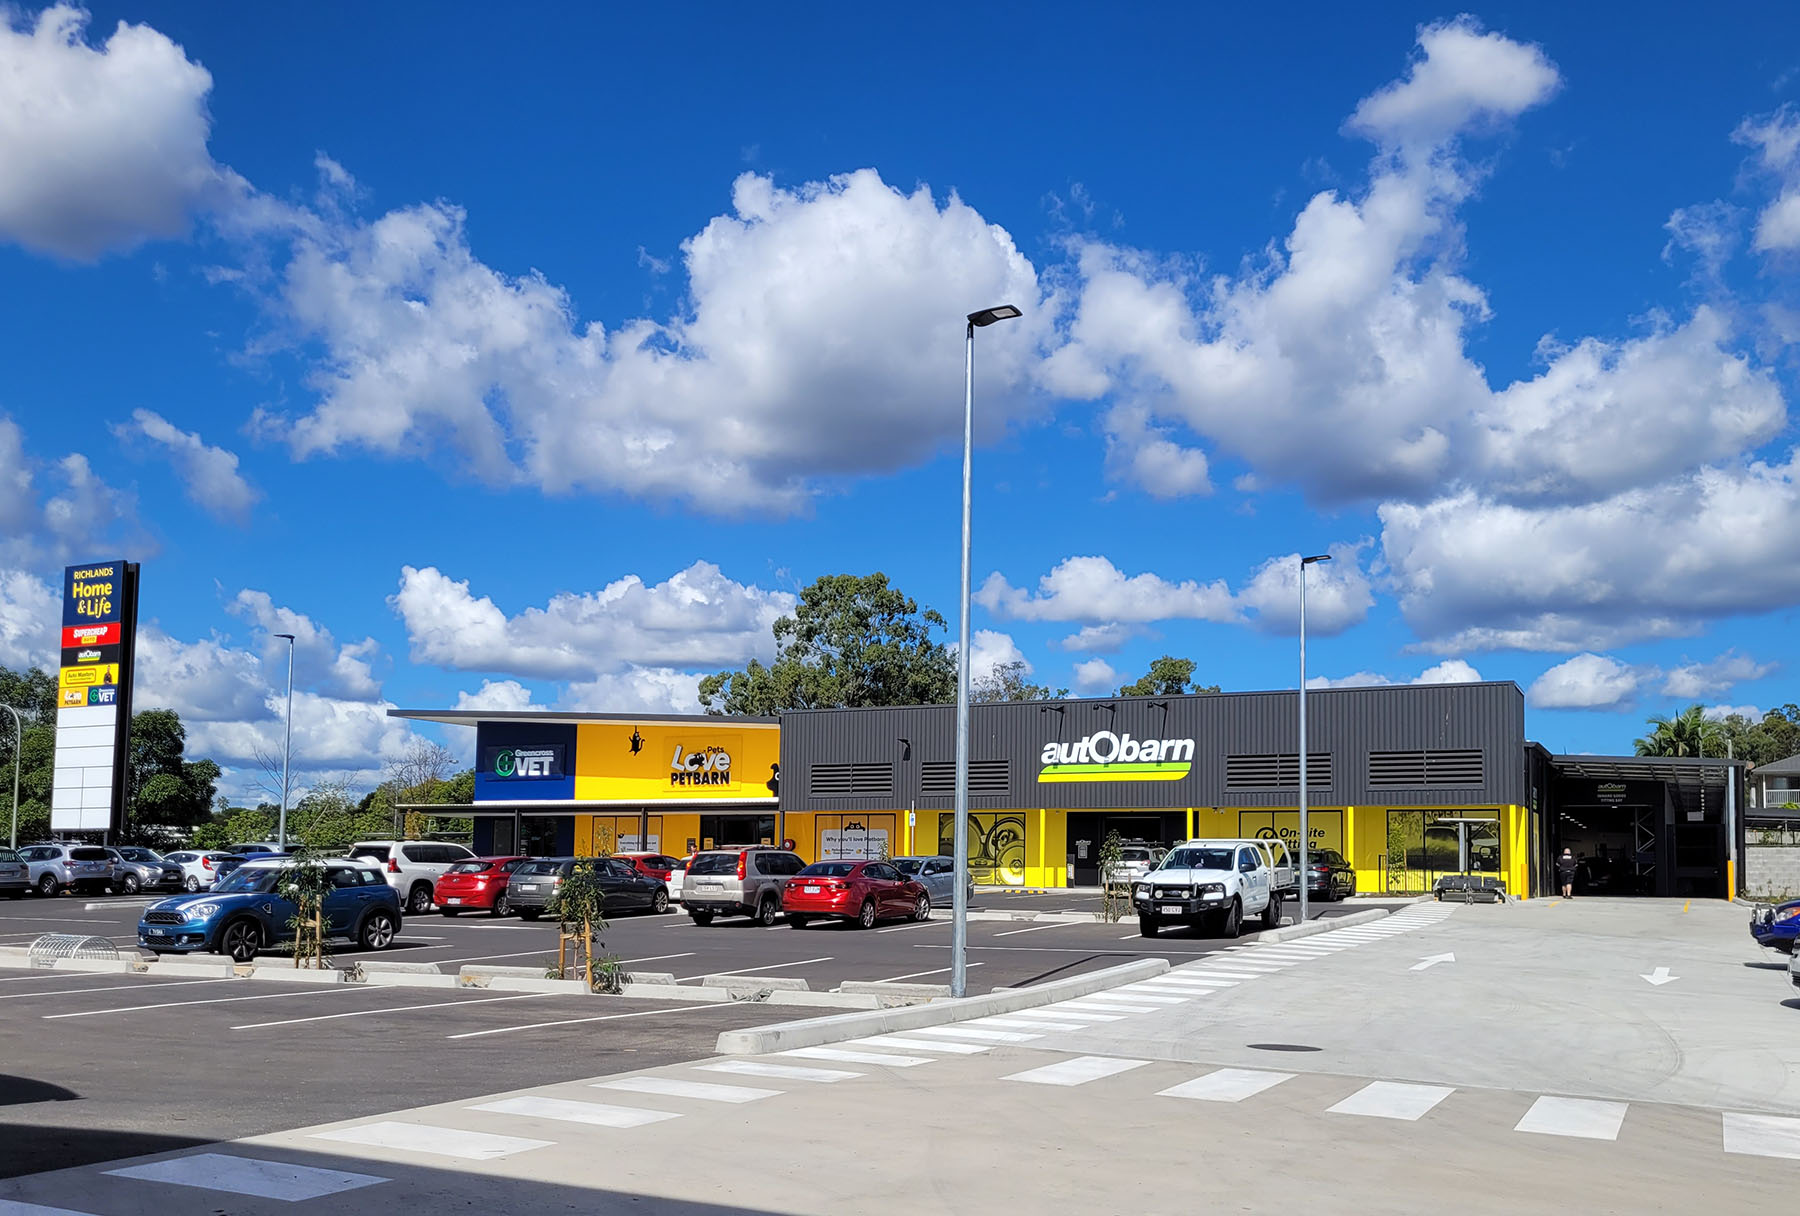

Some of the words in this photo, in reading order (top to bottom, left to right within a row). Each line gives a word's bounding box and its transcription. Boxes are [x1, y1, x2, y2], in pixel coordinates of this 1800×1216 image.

[74, 567, 113, 580] RICHLANDS
[73, 582, 112, 598] Home
[77, 600, 86, 613] &
[87, 597, 111, 618] Life
[73, 626, 108, 638] SUPERCHEAP
[98, 692, 115, 702] VET
[514, 749, 554, 757] Greencross
[671, 744, 731, 771] Love
[514, 756, 554, 776] VET
[670, 771, 731, 785] PETBARN
[1280, 827, 1325, 838] On-ite
